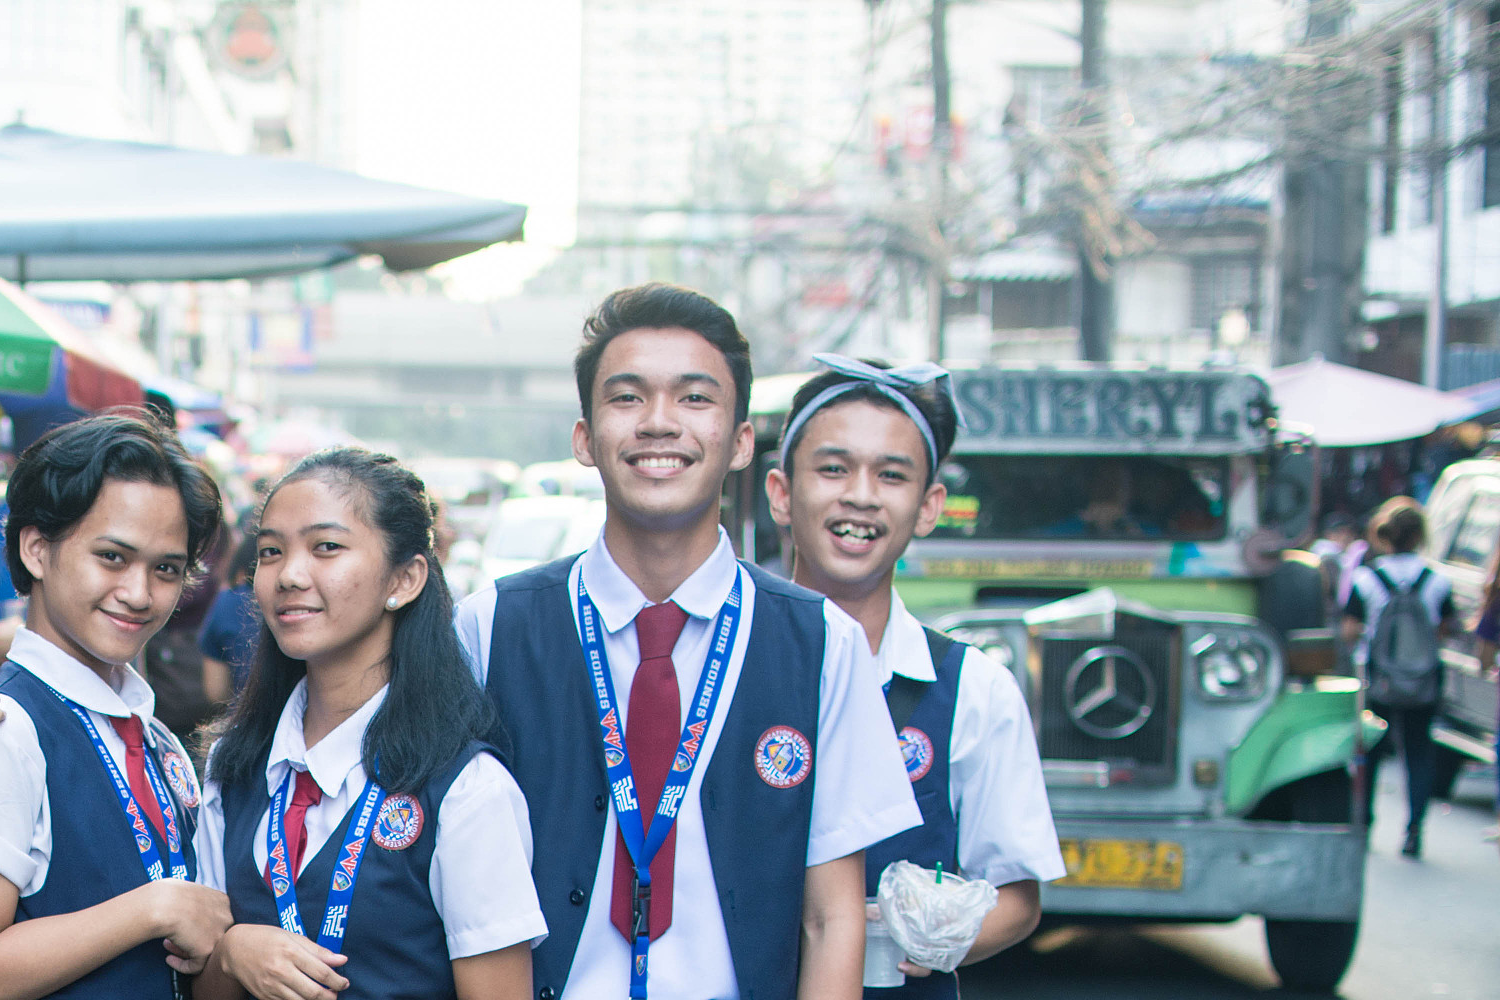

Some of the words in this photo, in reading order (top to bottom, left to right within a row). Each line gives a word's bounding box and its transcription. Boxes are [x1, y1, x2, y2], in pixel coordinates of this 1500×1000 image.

[959, 373, 1241, 440] SHERYL
[582, 604, 596, 644] HIGH
[588, 648, 611, 710] SENIOR
[682, 719, 708, 760] AMA
[695, 658, 722, 719] SENIOR
[715, 613, 734, 656] HIGH
[600, 707, 623, 750] AMA
[757, 729, 794, 751] EDUCATION
[793, 733, 811, 760] SYSTEM
[98, 744, 130, 799] SENIOR
[791, 765, 809, 783] HIGH
[126, 797, 149, 835] AMA
[271, 792, 283, 842] SENIOR
[269, 838, 289, 878] AMA
[340, 837, 366, 878] AMA
[383, 836, 411, 848] SYSTEM
